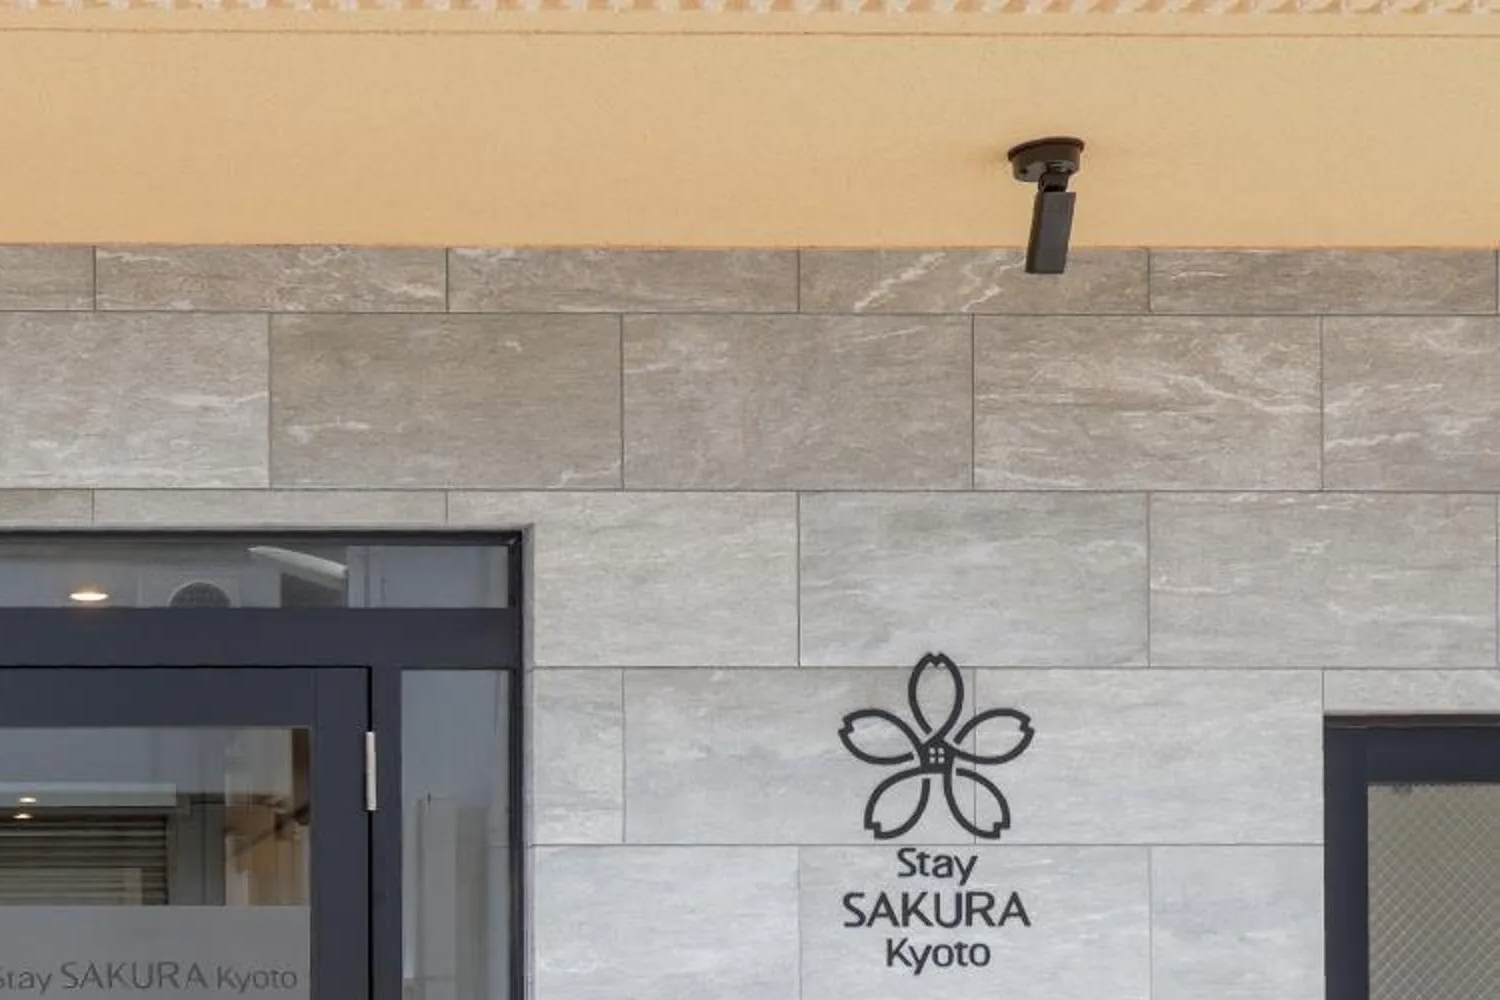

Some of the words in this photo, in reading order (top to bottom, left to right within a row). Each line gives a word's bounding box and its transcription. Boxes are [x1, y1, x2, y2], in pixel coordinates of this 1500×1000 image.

[897, 847, 978, 885] Stay
[842, 891, 1031, 928] SAKURA
[886, 938, 991, 976] Kyoto
[60, 961, 208, 990] SAKURA
[217, 966, 298, 994] Kyoto
